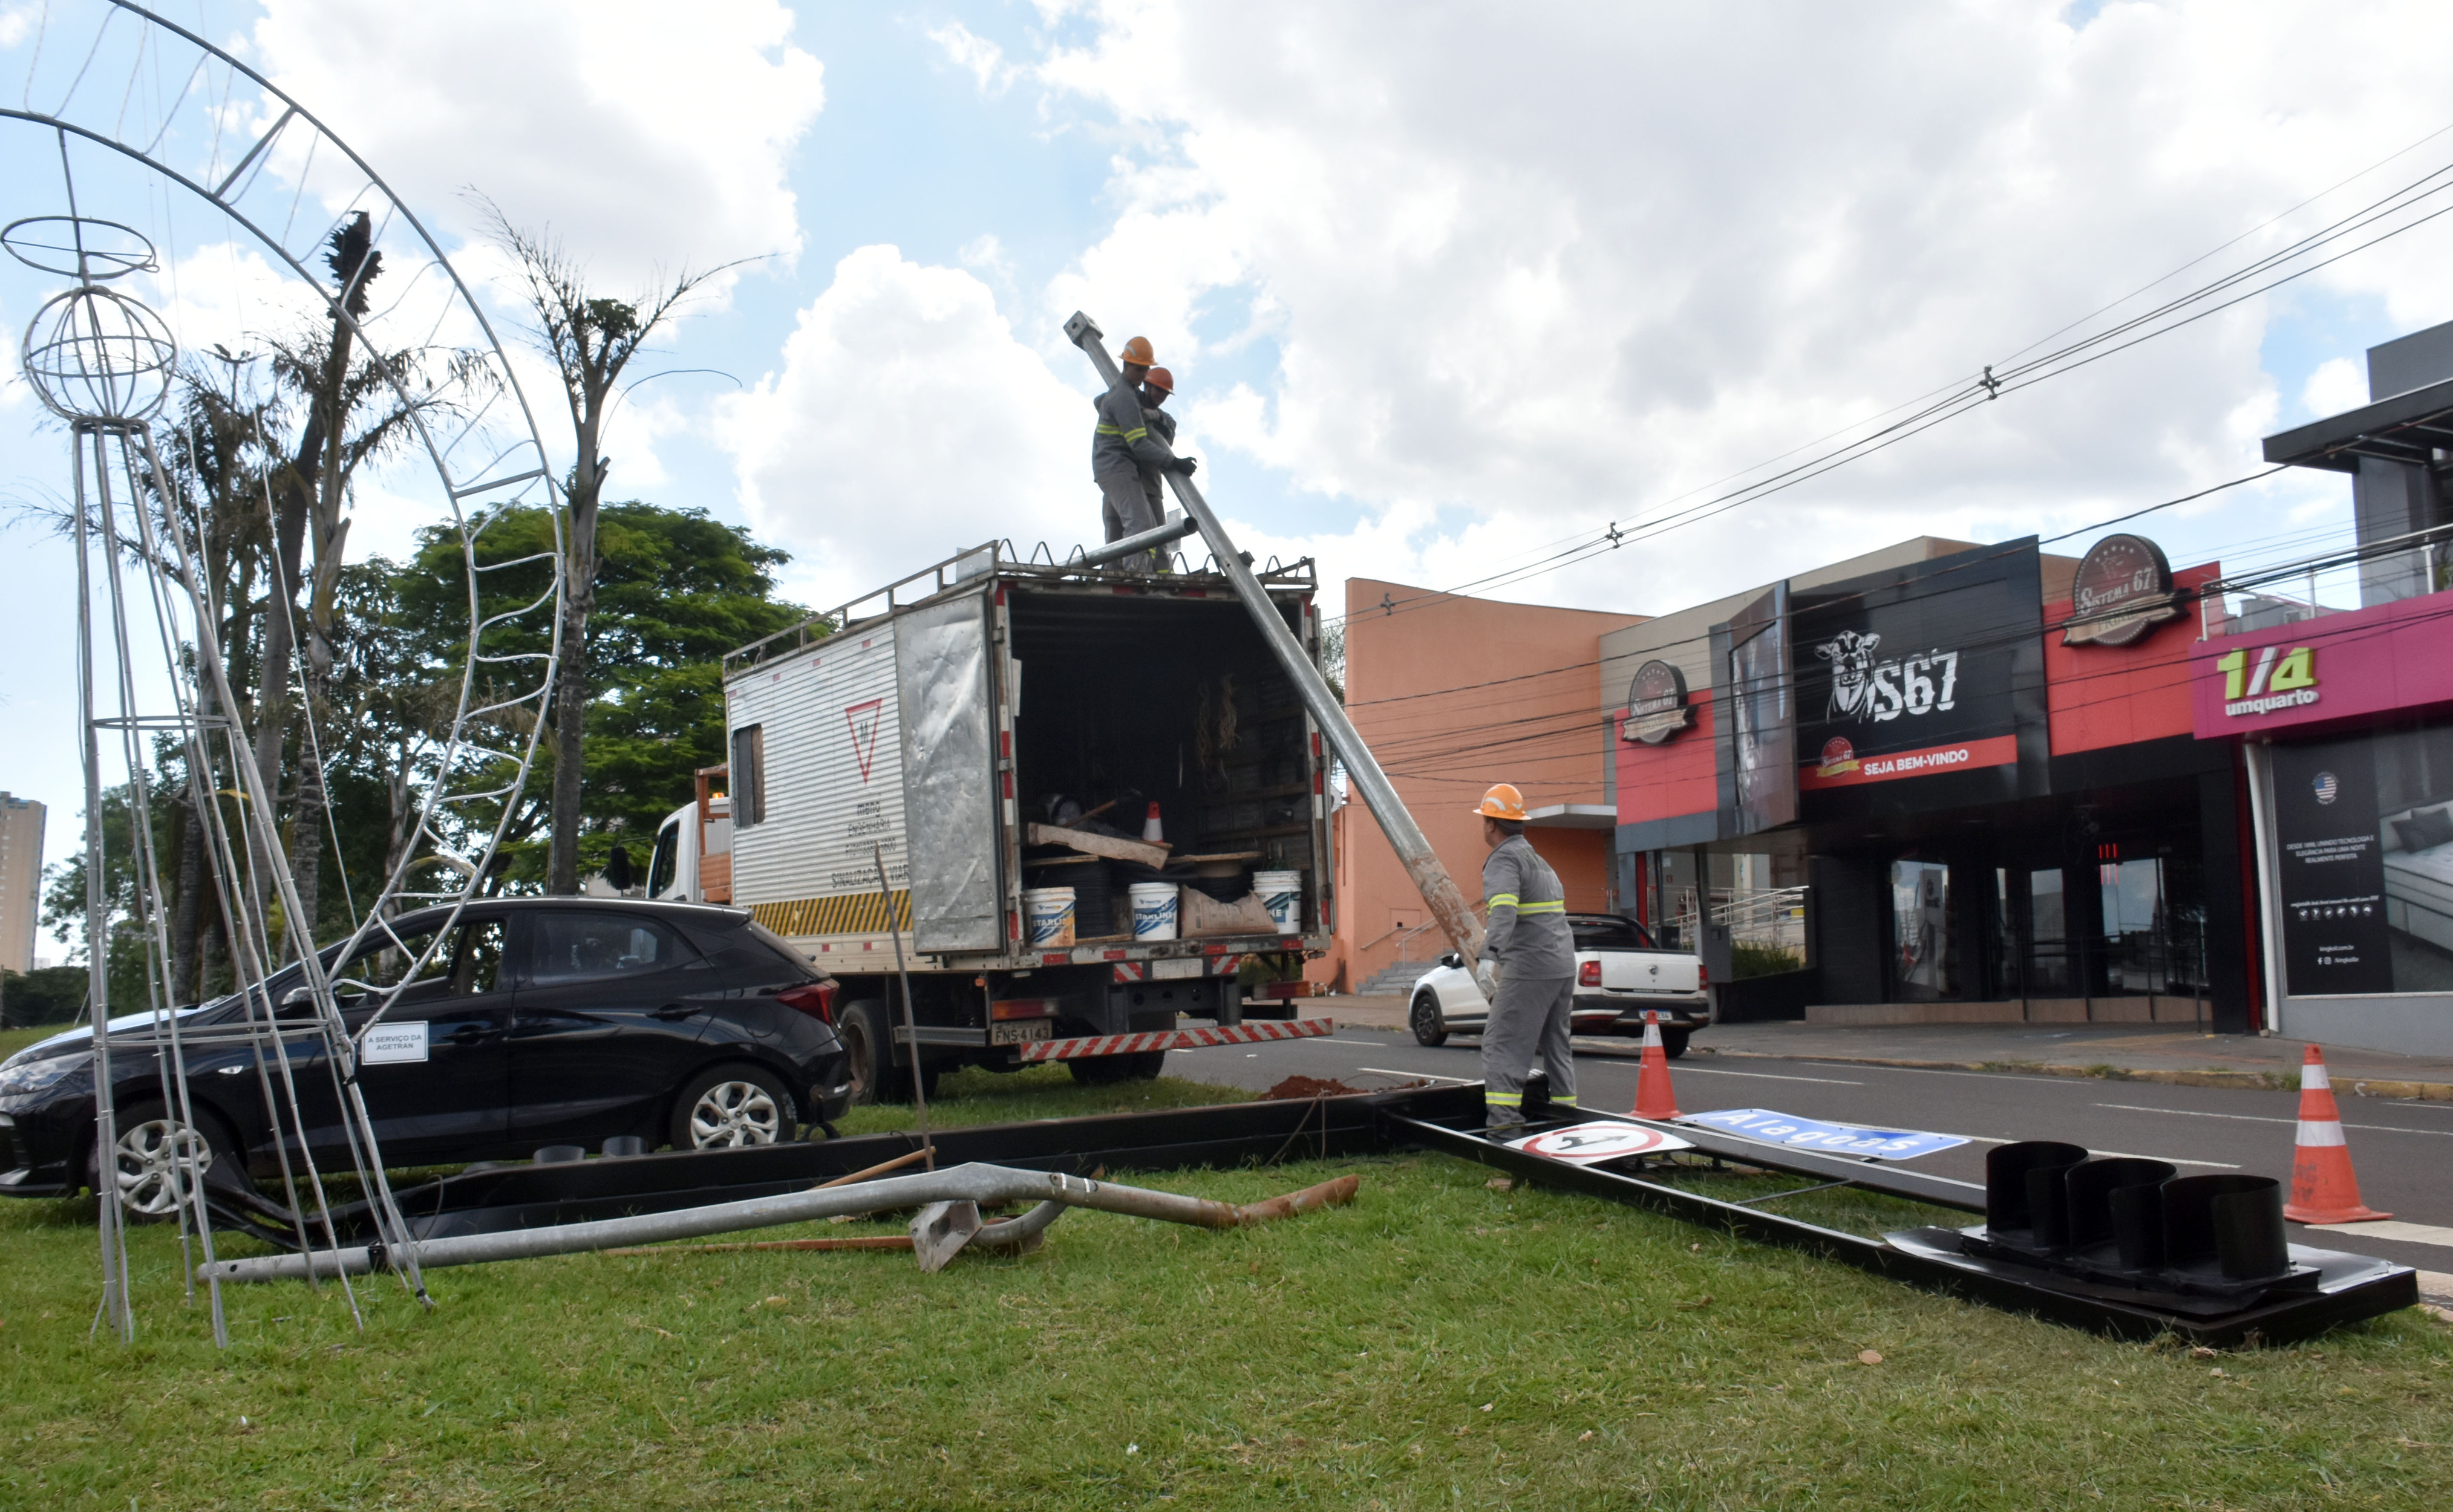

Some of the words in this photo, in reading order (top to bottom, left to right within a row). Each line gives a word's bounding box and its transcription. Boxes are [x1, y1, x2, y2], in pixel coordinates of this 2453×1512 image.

[2133, 567, 2152, 591] 67
[1874, 648, 1958, 722] S67
[2217, 647, 2318, 700] 1/4
[2225, 688, 2319, 716] umquarto
[1864, 760, 1895, 776] SEJA
[1896, 749, 1968, 771] BEM-VINDO
[376, 1035, 410, 1043] SERVIÇO
[1707, 1114, 1920, 1151] Alagoas
